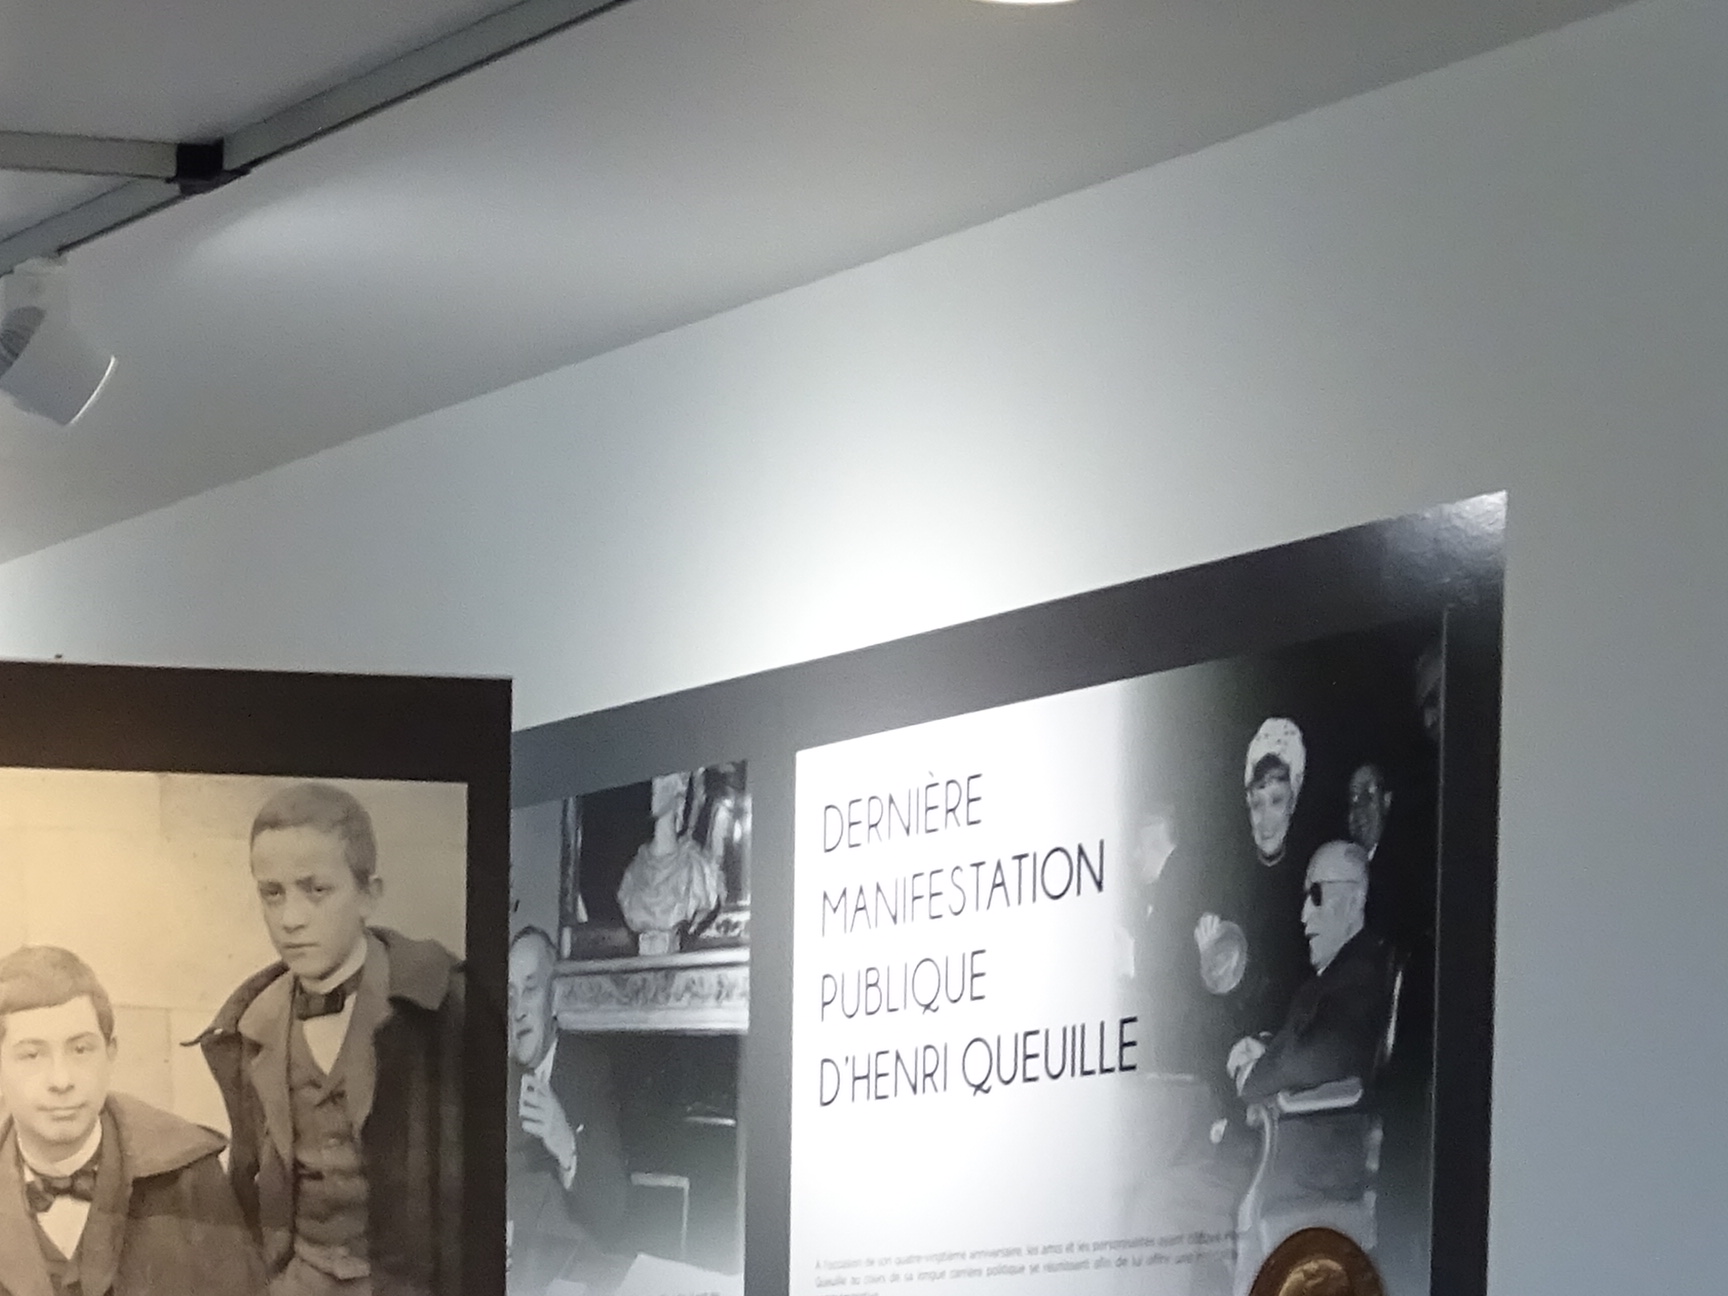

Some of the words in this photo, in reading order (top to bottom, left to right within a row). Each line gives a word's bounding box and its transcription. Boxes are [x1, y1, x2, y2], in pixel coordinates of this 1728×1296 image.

[823, 770, 983, 853] DERNIÈRE
[821, 839, 1105, 937] MANIFESTATION
[821, 949, 987, 1022] PUBLIQUE
[819, 1042, 948, 1106] D'HENRI
[961, 1016, 1139, 1097] QUEUILLE
